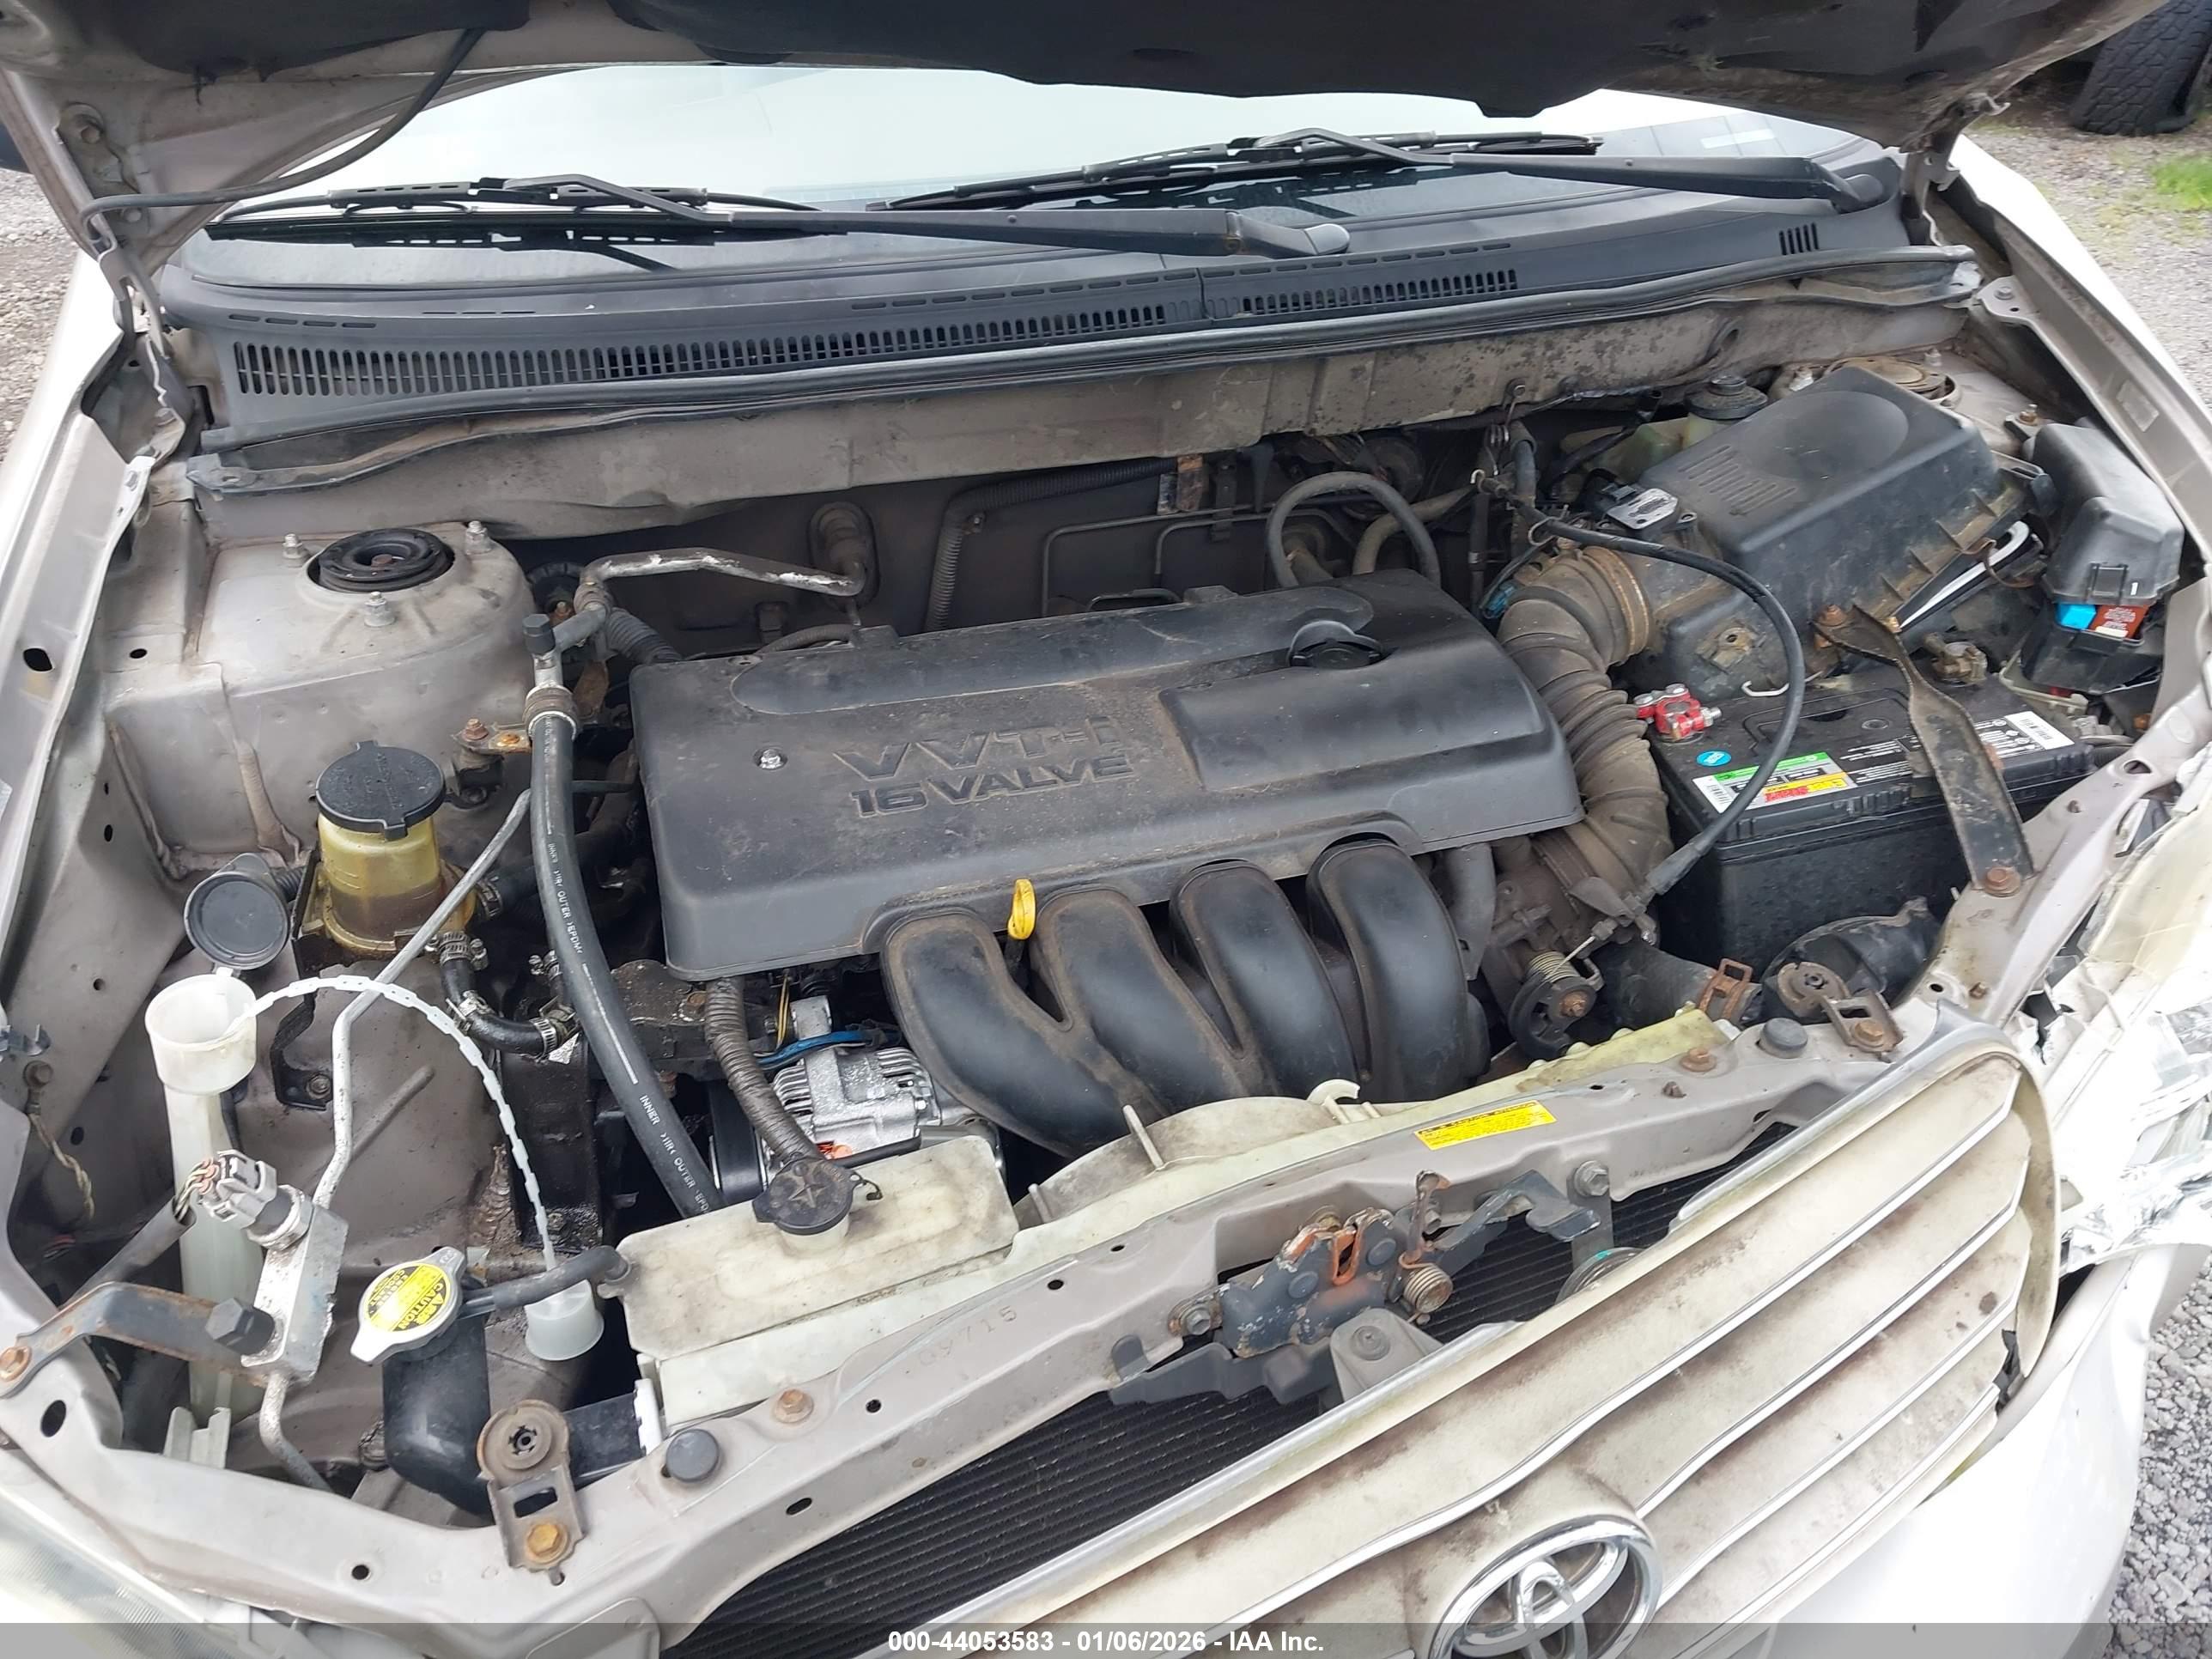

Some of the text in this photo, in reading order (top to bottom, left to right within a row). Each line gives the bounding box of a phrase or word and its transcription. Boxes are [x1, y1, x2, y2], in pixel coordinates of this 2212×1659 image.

[556, 890, 572, 920] OUTER
[639, 1094, 660, 1126] INNER
[673, 1157, 696, 1189] OUTER
[398, 1282, 444, 1330] CAUTION
